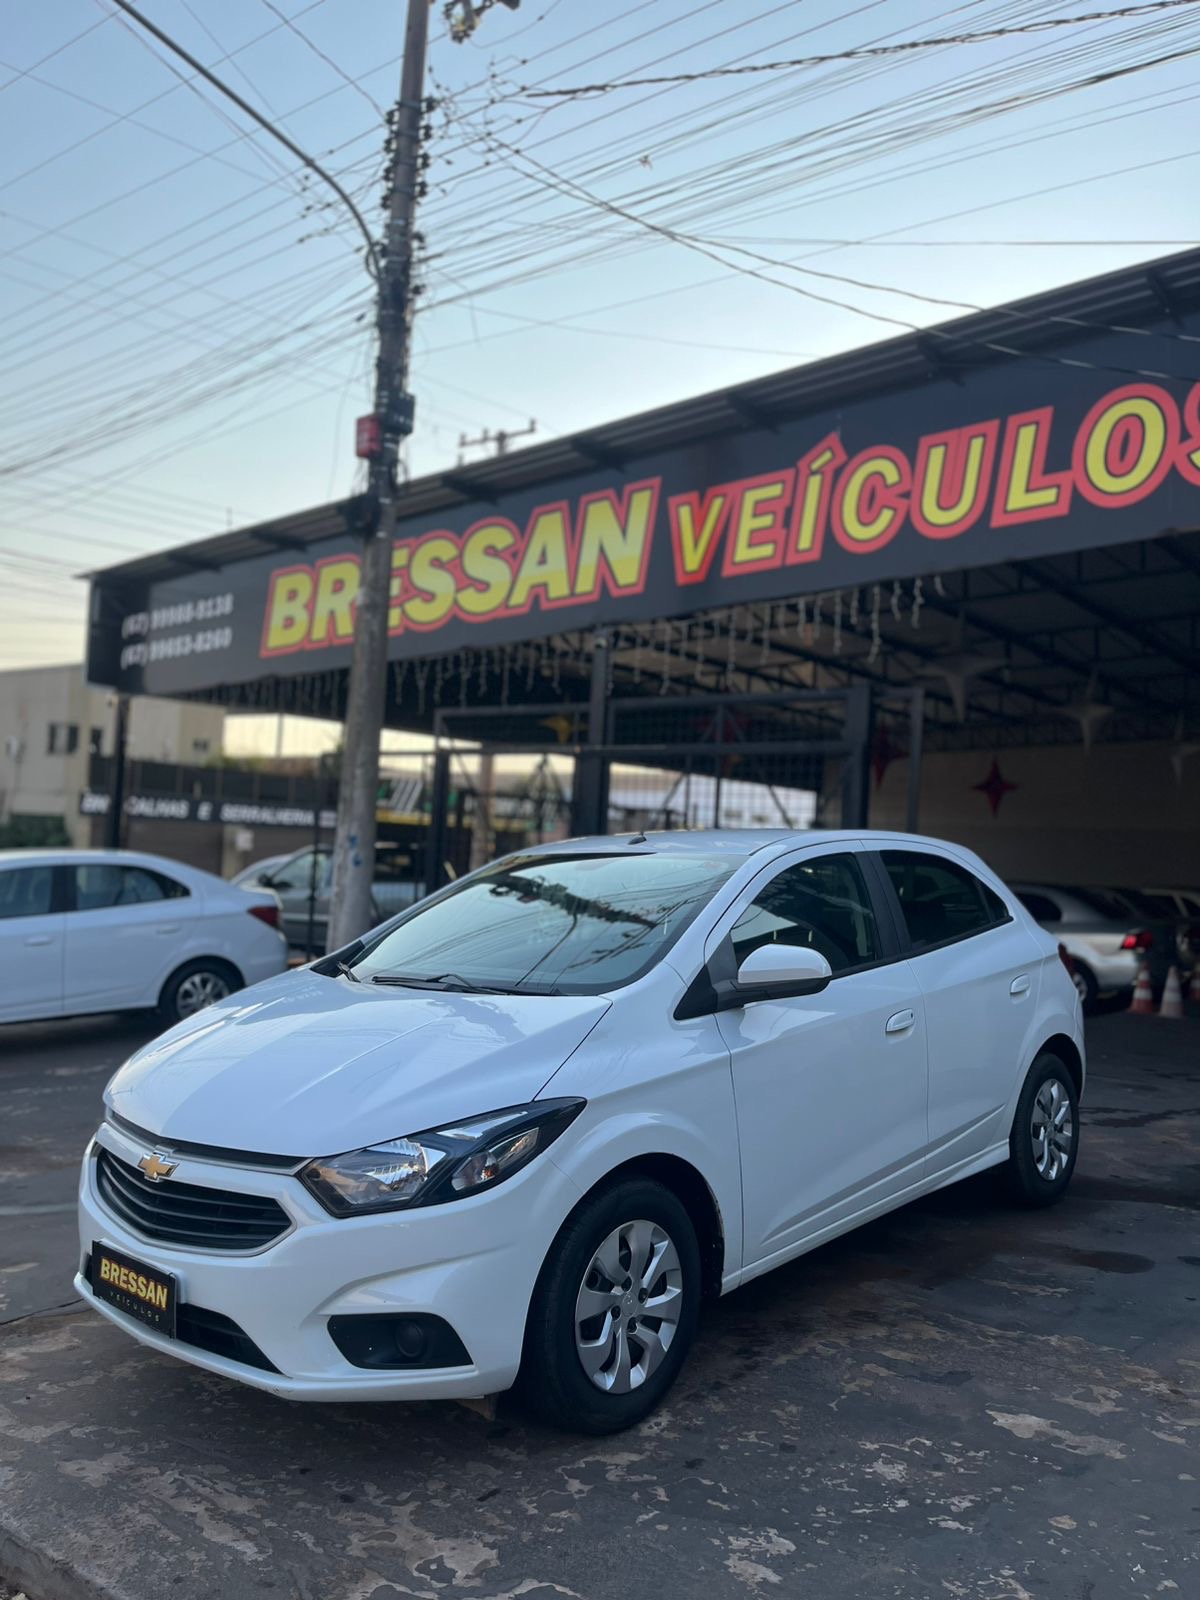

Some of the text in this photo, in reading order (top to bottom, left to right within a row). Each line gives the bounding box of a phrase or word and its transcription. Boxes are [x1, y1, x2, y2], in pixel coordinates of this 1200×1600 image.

[668, 382, 1200, 586] VEÍCULO
[197, 801, 213, 821] E
[100, 1257, 169, 1311] BRESSAN
